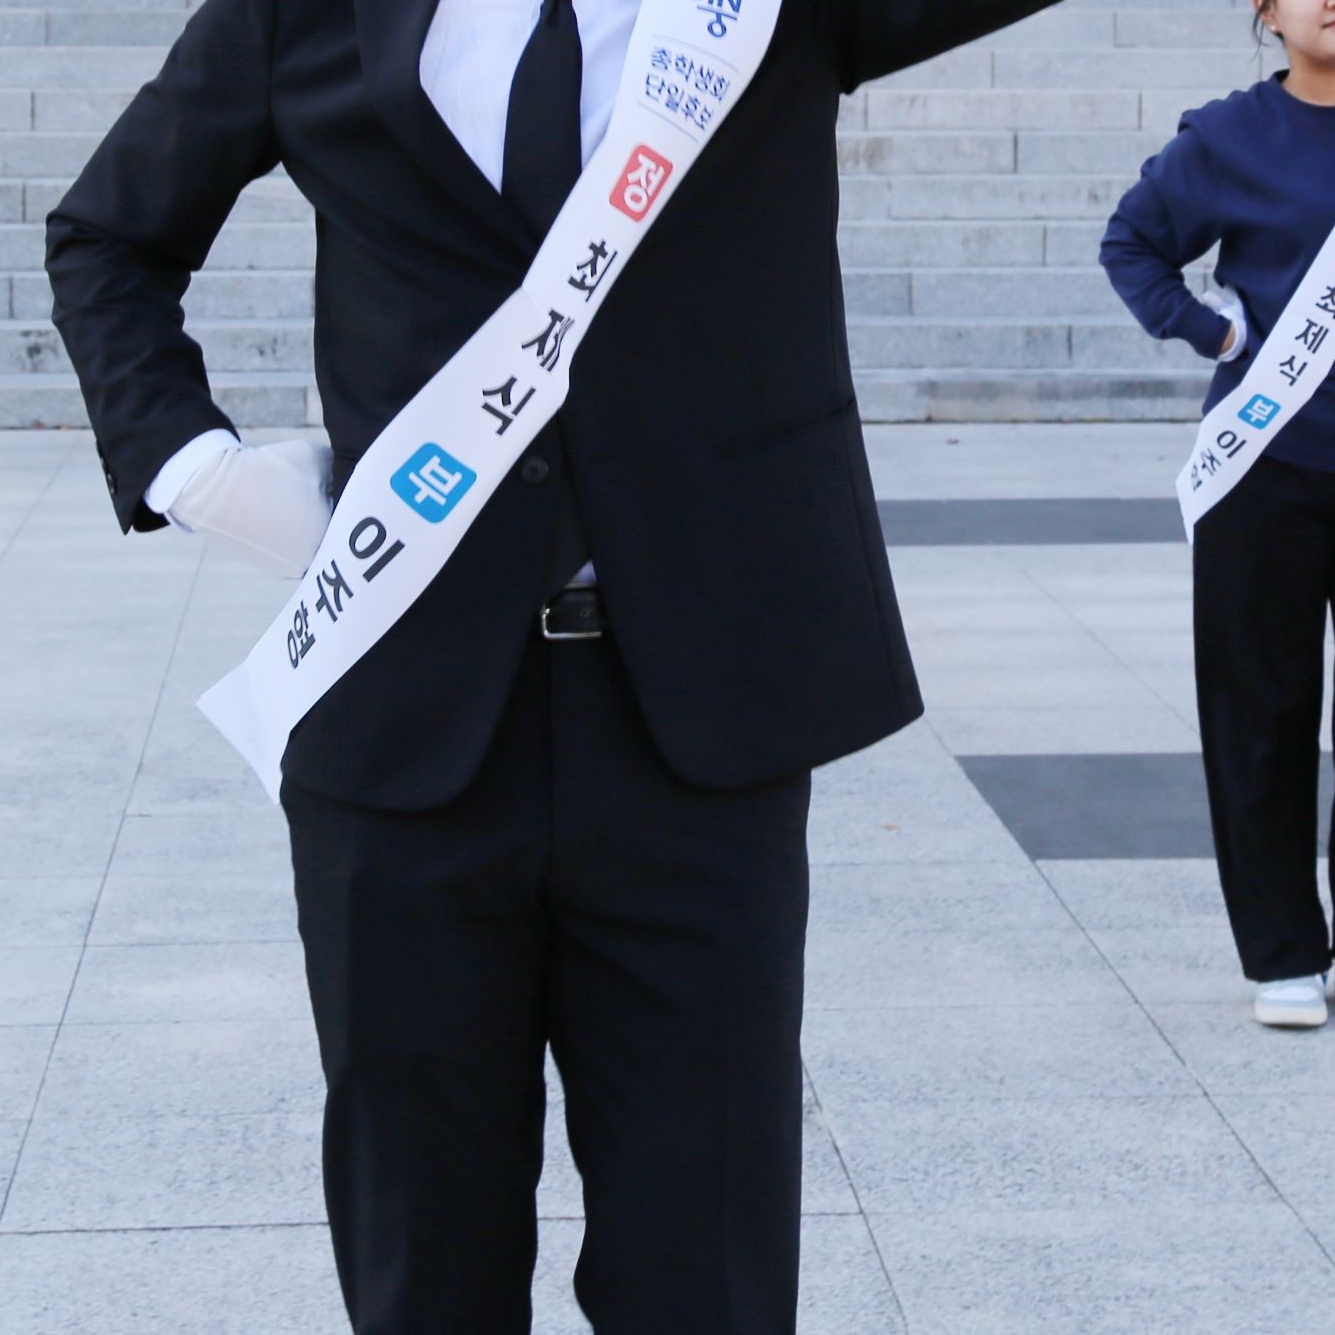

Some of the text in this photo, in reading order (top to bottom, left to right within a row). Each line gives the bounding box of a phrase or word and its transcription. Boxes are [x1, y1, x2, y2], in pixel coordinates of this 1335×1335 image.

[645, 73, 713, 131] 단일후보
[650, 46, 731, 102] 총학생회
[287, 153, 665, 669] 정 최제식 부 이주형
[1246, 398, 1274, 425] 부
